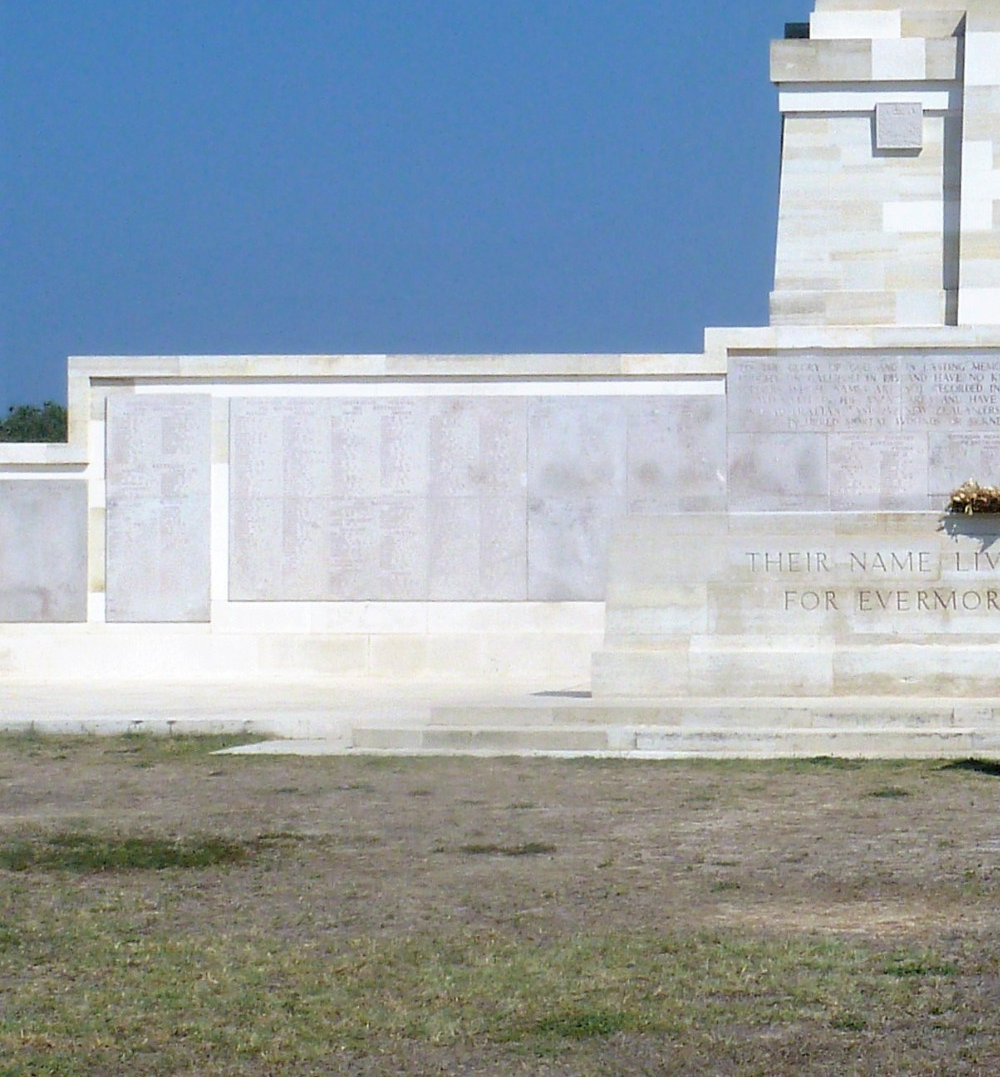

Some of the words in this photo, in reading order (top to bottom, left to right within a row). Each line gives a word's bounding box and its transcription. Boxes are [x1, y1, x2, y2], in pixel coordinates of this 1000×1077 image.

[934, 373, 961, 382] HAVE
[969, 373, 986, 382] NO
[989, 383, 1000, 393] IN
[969, 394, 997, 403] HAVE
[745, 552, 830, 573] THEIR
[850, 552, 932, 573] NAME
[784, 591, 839, 612] FOR
